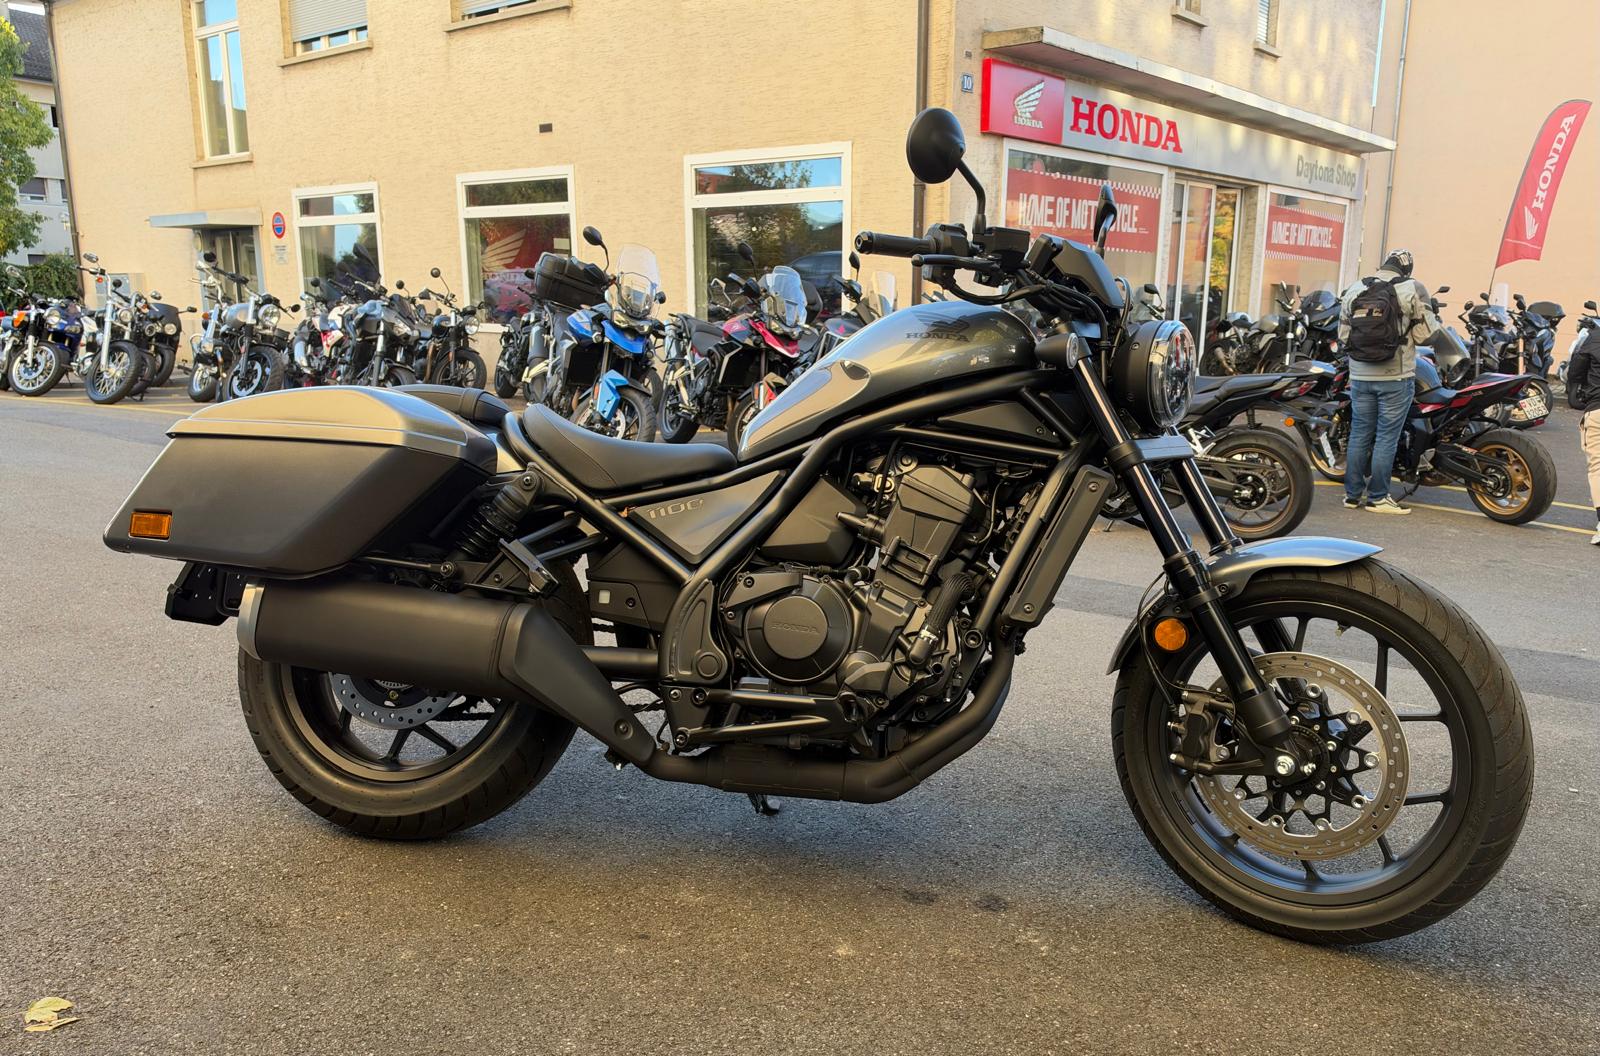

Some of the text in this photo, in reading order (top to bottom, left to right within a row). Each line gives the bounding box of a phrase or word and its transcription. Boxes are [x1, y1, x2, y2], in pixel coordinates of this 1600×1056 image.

[963, 75, 972, 90] 10
[1014, 116, 1043, 128] HONDA
[1070, 95, 1183, 153] HONDA
[1296, 153, 1357, 192] Daytona Shop
[1532, 113, 1576, 211] HONDA
[1055, 196, 1070, 230] OF
[1070, 198, 1139, 234] MOTYCLE
[905, 331, 971, 343] HONDA
[646, 498, 705, 520] 1100
[770, 621, 821, 635] HONDA
